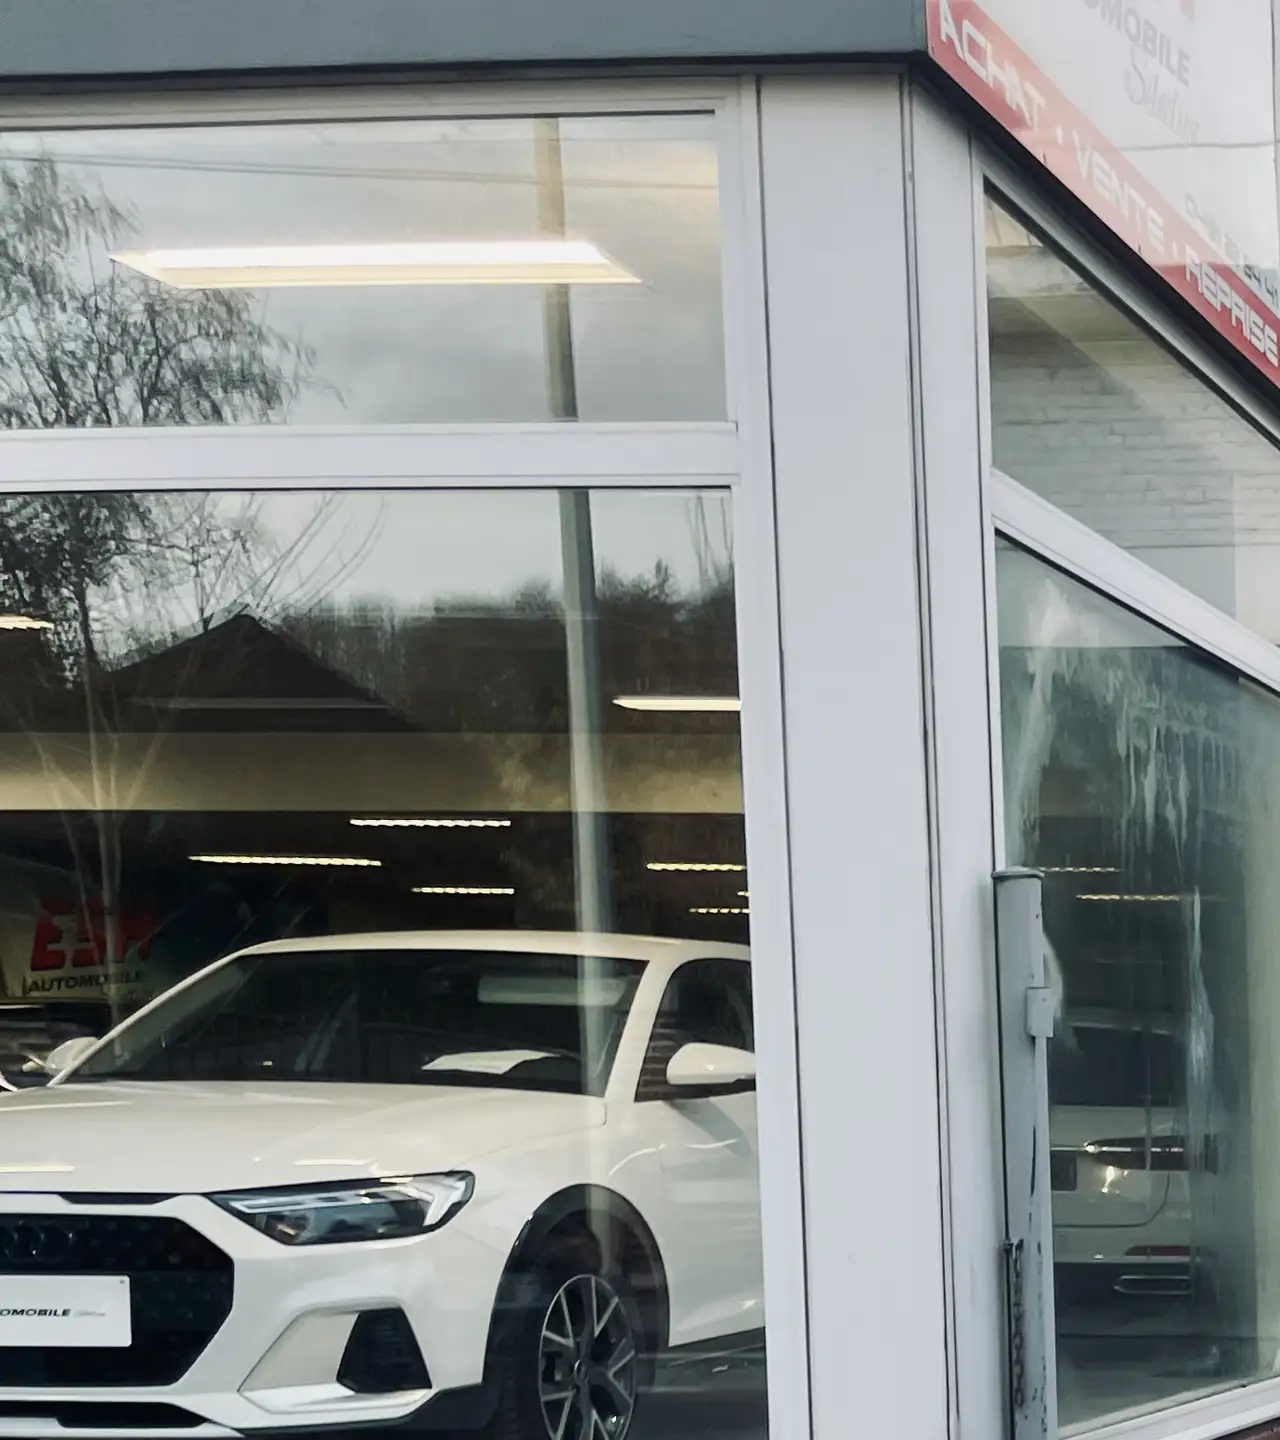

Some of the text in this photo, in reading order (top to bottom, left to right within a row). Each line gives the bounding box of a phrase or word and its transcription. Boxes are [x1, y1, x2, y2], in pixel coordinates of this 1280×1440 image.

[1084, 0, 1190, 88] MOBILE
[940, 0, 1045, 134] ACHAT
[1073, 131, 1164, 257] VENTE
[1185, 243, 1279, 368] REPRISE
